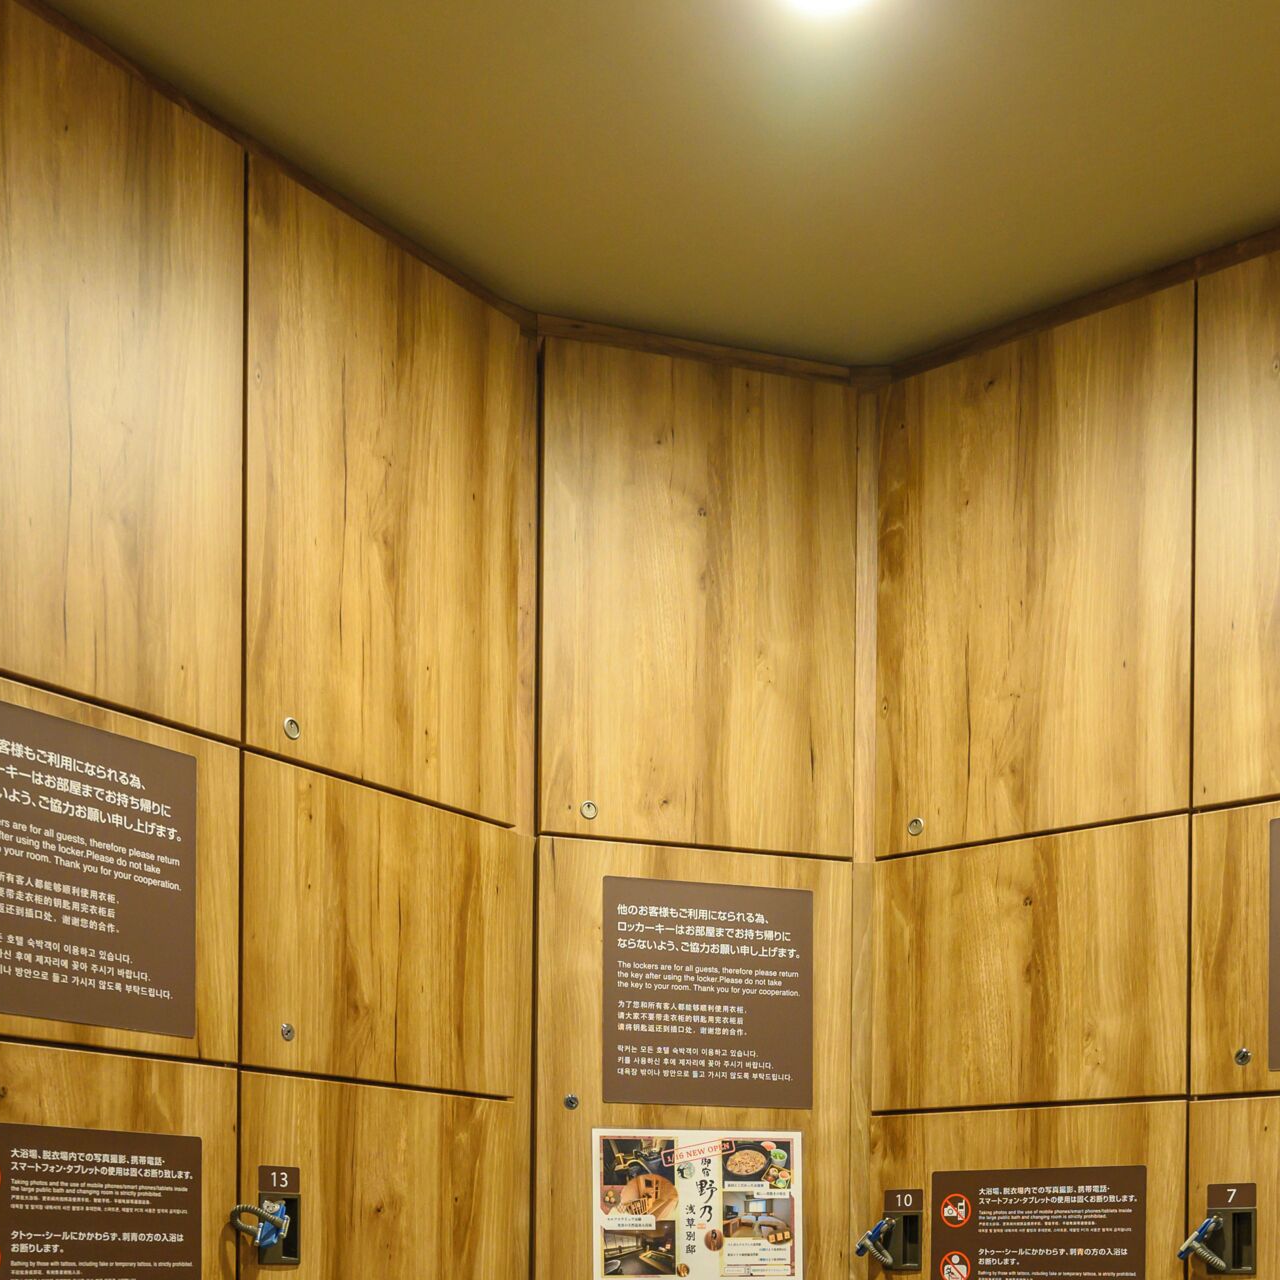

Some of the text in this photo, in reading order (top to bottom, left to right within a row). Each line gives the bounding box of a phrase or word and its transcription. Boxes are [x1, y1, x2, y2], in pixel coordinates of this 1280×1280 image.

[12, 821, 27, 832] are
[29, 823, 42, 835] for
[43, 828, 54, 838] all
[55, 831, 87, 846] guests,
[89, 838, 127, 854] therefore
[128, 847, 155, 861] please
[156, 854, 180, 866] return
[15, 835, 40, 850] using
[41, 840, 56, 851] the
[58, 843, 114, 864] locker.Please
[116, 856, 127, 867] do
[128, 860, 142, 870] not
[143, 862, 161, 874] take
[616, 903, 769, 924] 他のお客様もご利用になられる為、
[617, 921, 791, 941] ロッカーキーはお部屋までお持ち帰りに
[617, 937, 800, 959] ならないよう、ご協力お願い申し上げます。
[686, 1148, 706, 1158] NEW
[708, 1142, 730, 1153] OPEN
[270, 1171, 289, 1188] 13
[895, 1193, 913, 1207] 10
[1226, 1188, 1237, 1203] 7
